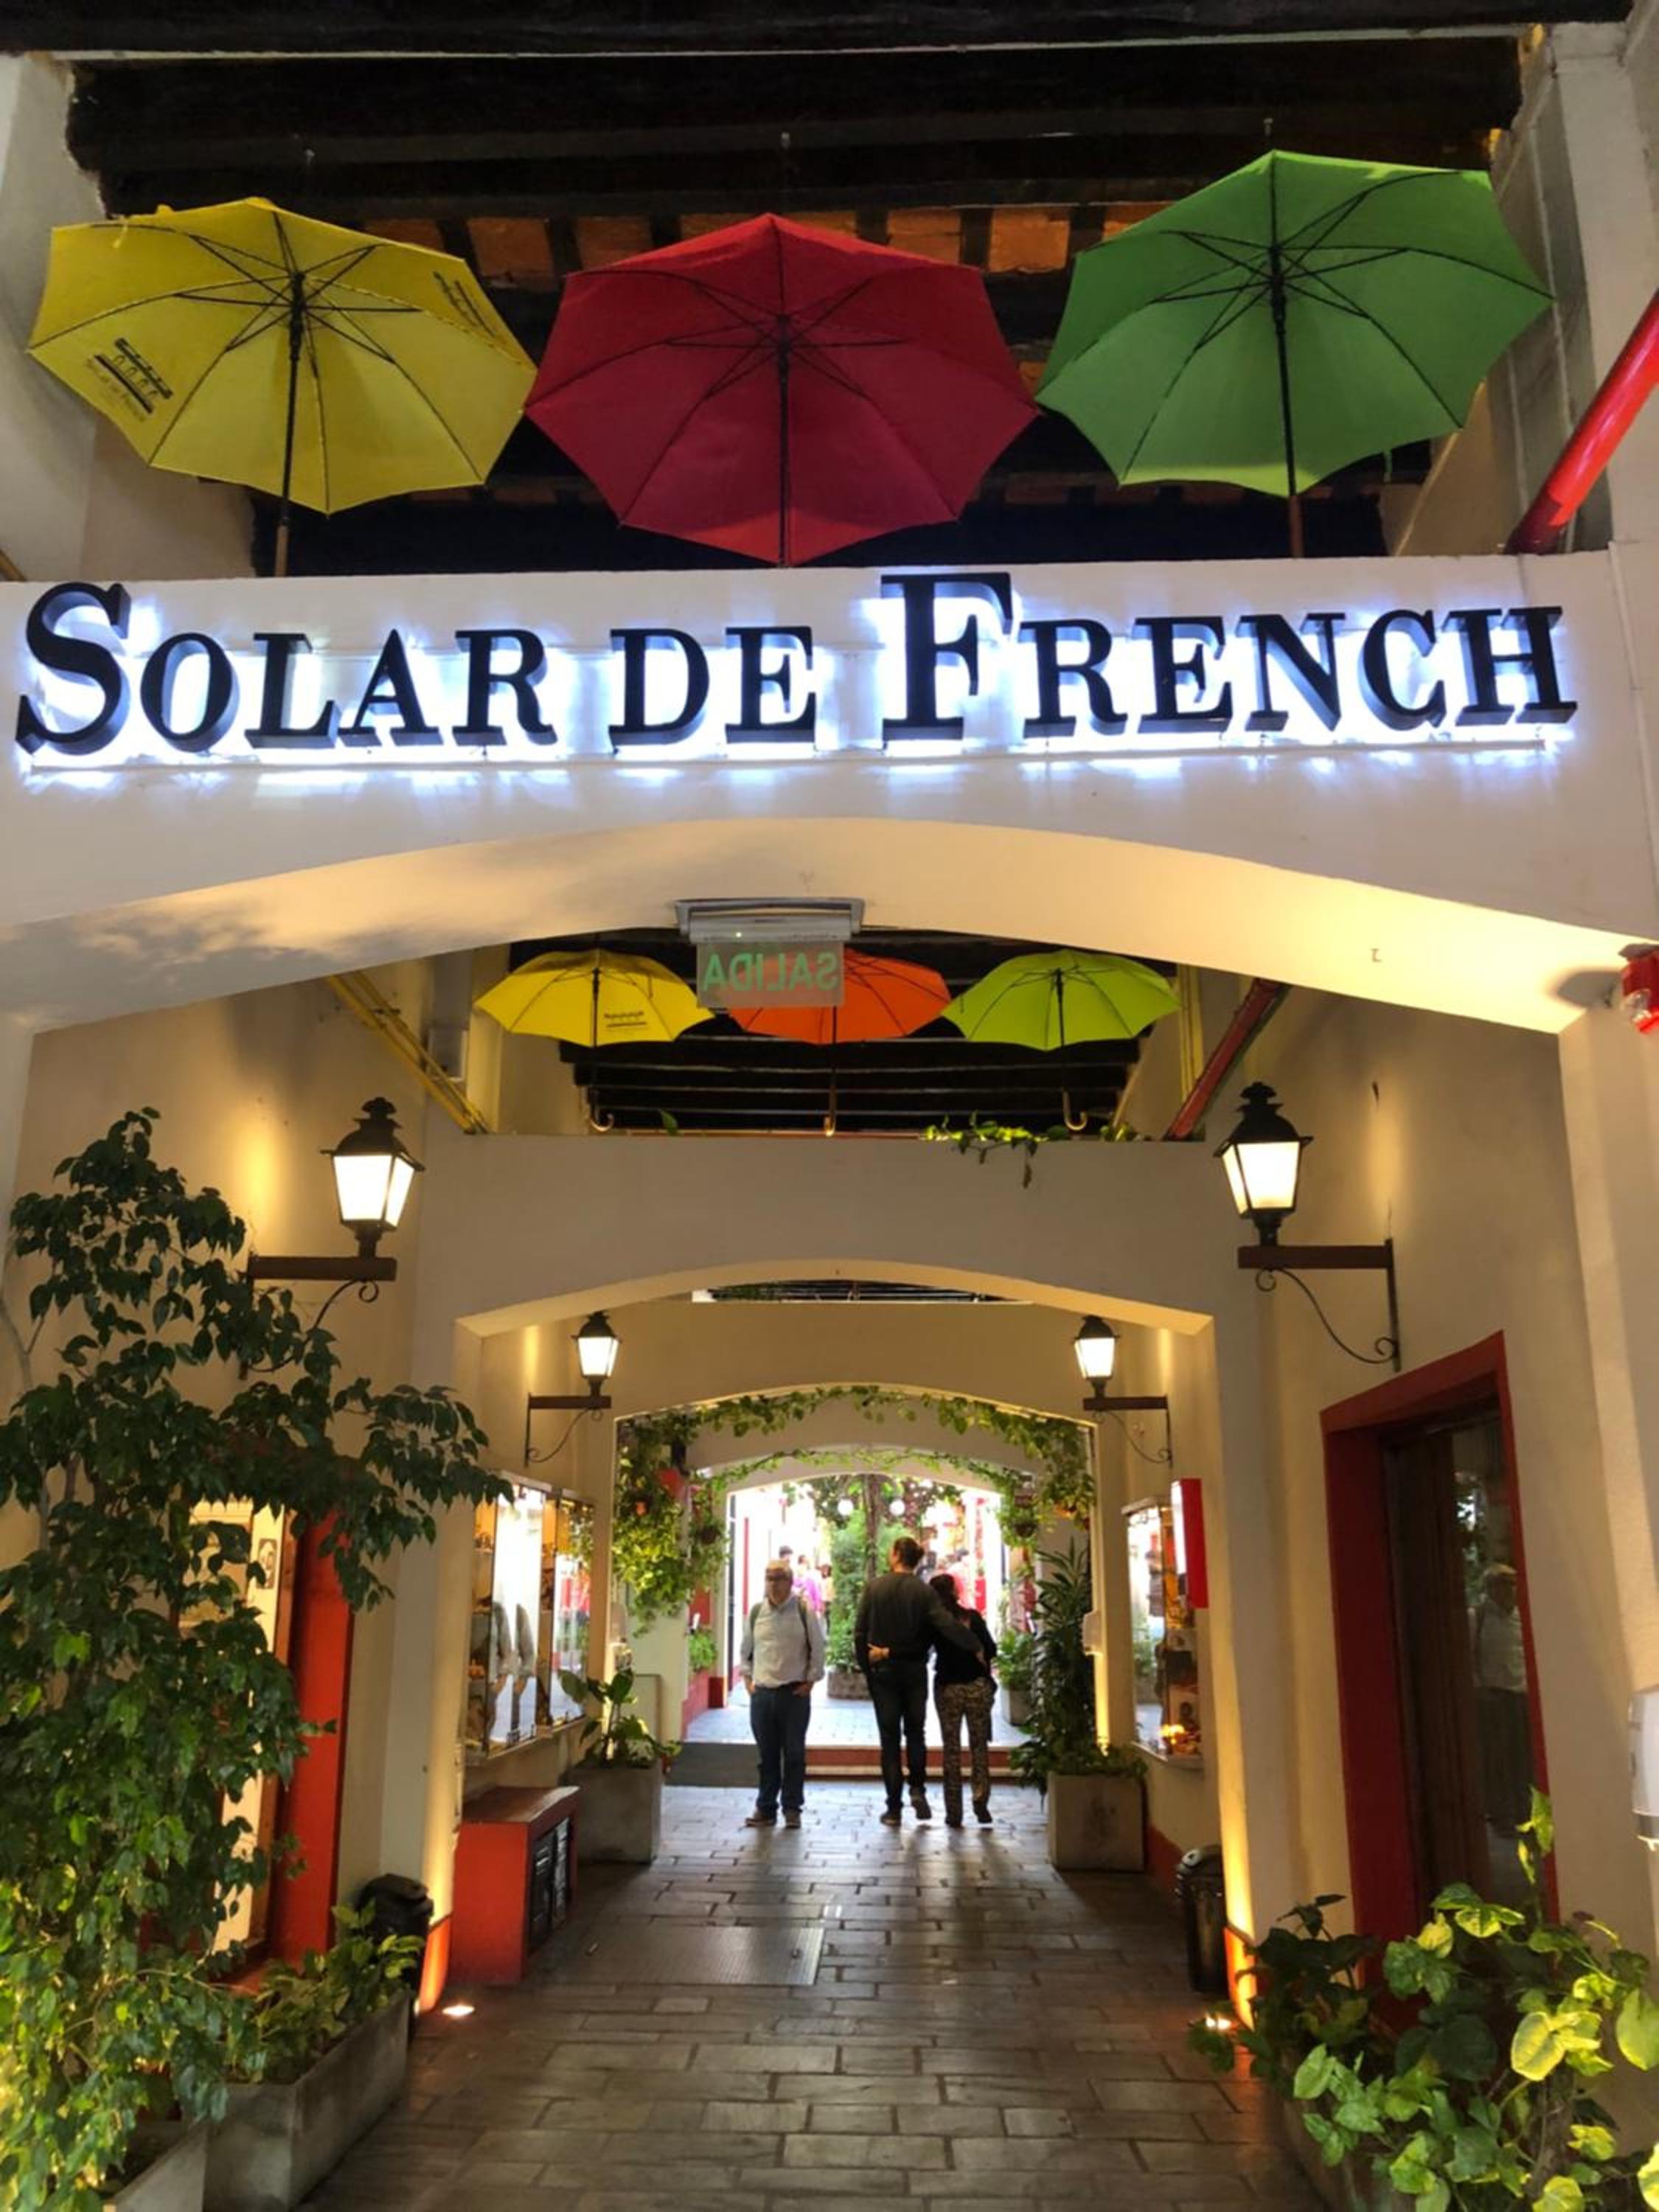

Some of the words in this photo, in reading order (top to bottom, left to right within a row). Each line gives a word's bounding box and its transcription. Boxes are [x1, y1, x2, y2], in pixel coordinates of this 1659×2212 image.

[15, 581, 557, 755] SOLAR
[608, 626, 817, 747] DE
[880, 571, 1578, 742] FRENCH
